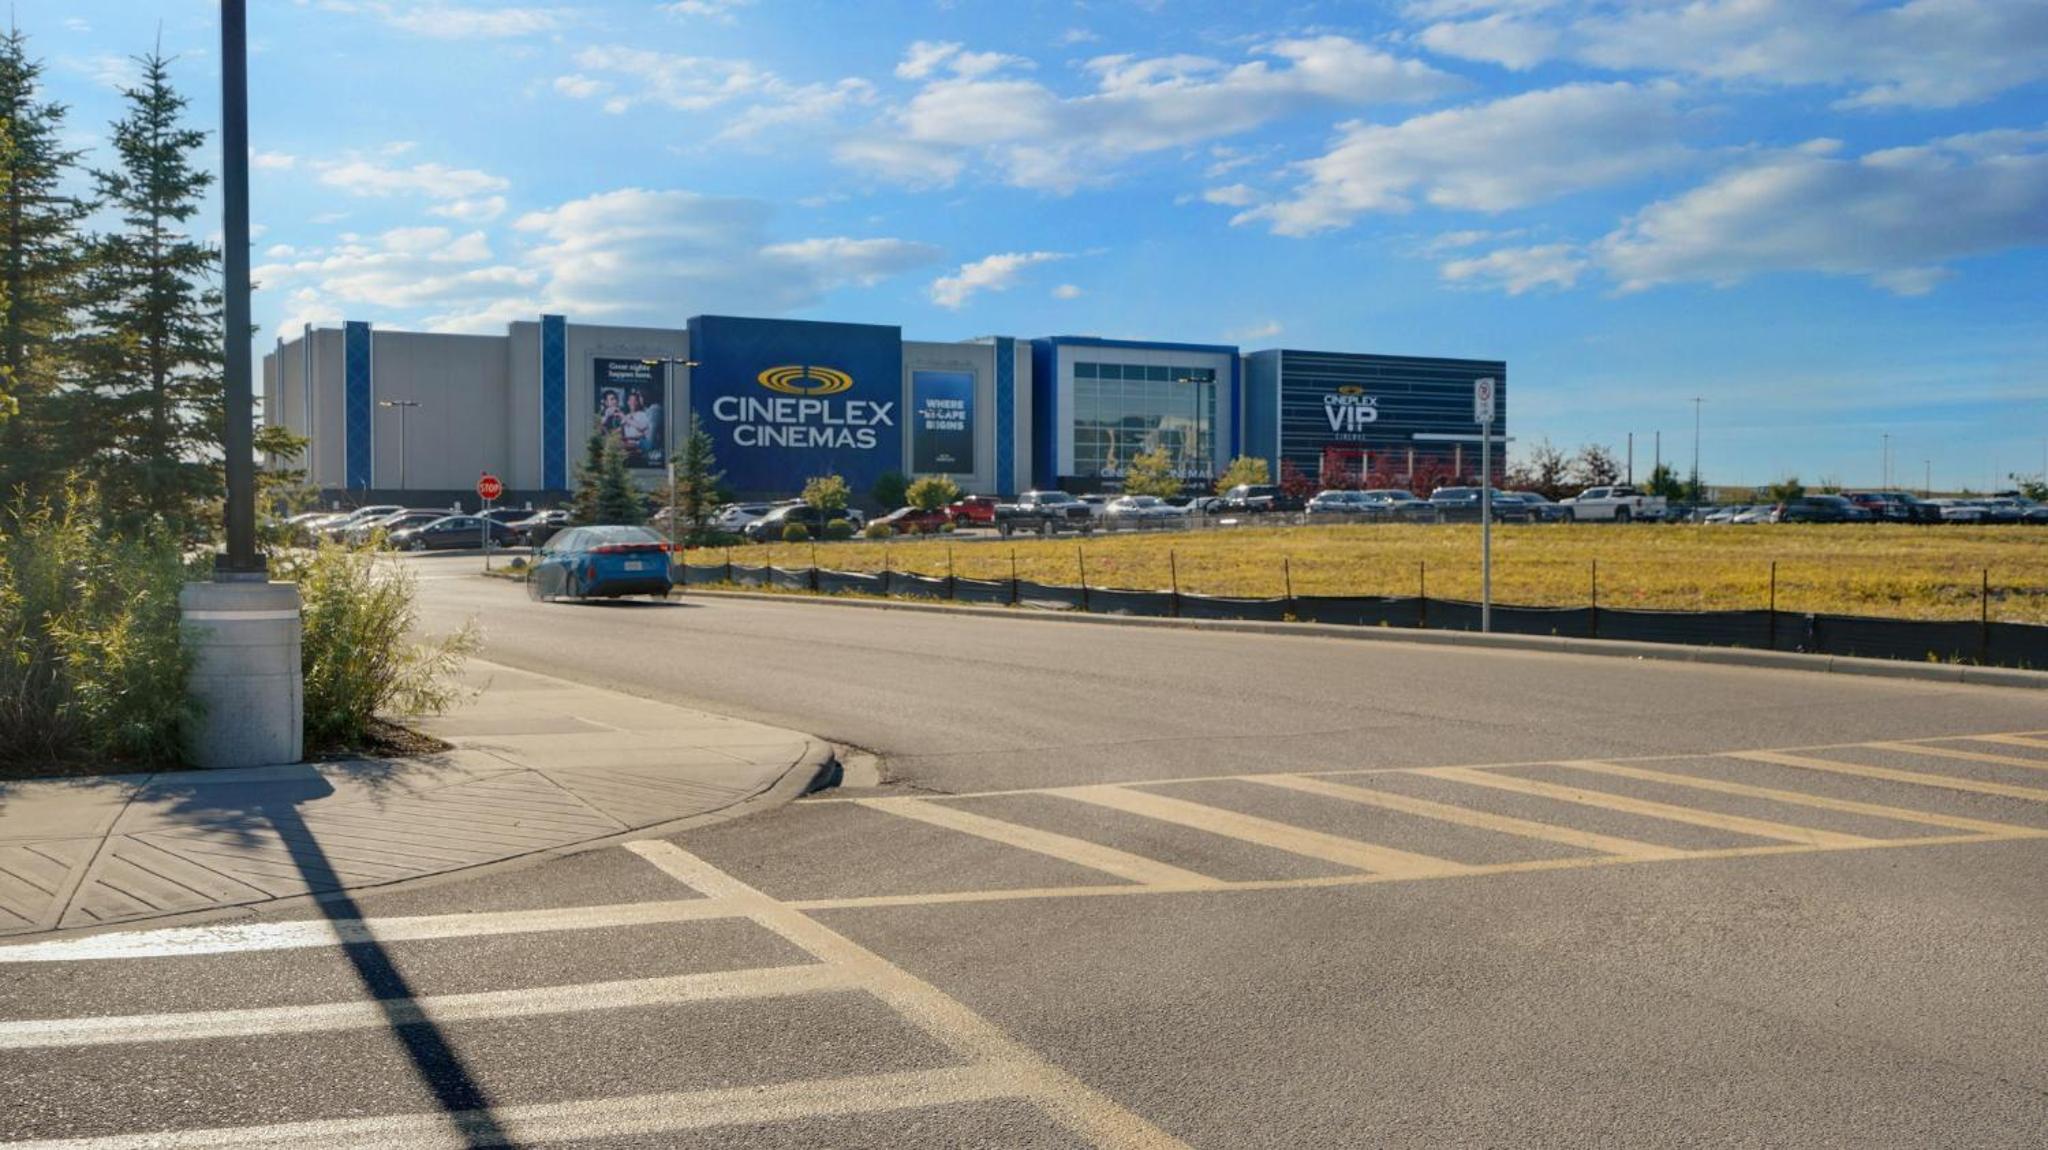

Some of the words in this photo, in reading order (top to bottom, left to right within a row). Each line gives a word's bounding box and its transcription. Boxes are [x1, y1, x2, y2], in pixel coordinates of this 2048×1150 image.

[926, 399, 964, 409] WHERE
[1324, 394, 1377, 406] CINEPLEX
[712, 396, 894, 426] CINEPLEX
[1325, 405, 1378, 431] VIP
[926, 420, 964, 430] BEGINS
[733, 424, 877, 449] CINEMAS
[480, 483, 499, 492] STOP
